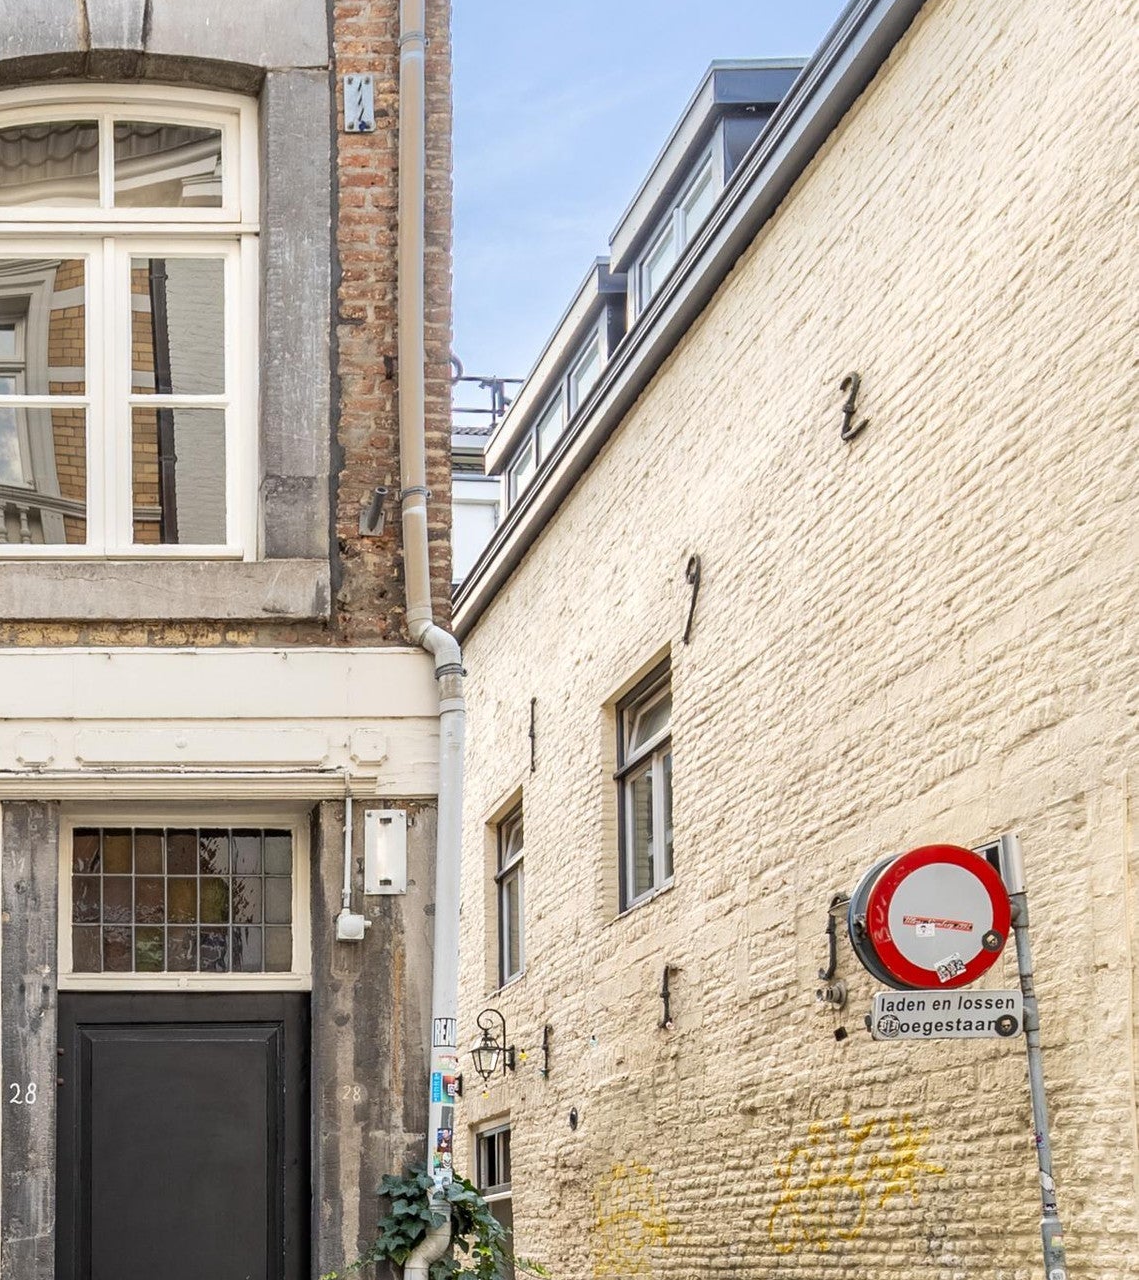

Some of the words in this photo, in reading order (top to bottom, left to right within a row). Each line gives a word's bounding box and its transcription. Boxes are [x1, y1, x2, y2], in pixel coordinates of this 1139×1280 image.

[881, 998, 925, 1012] laden
[932, 999, 951, 1010] en
[958, 996, 1015, 1010] lossen
[900, 1018, 998, 1035] oegestaan
[9, 1082, 37, 1105] 28
[342, 1085, 361, 1101] 28
